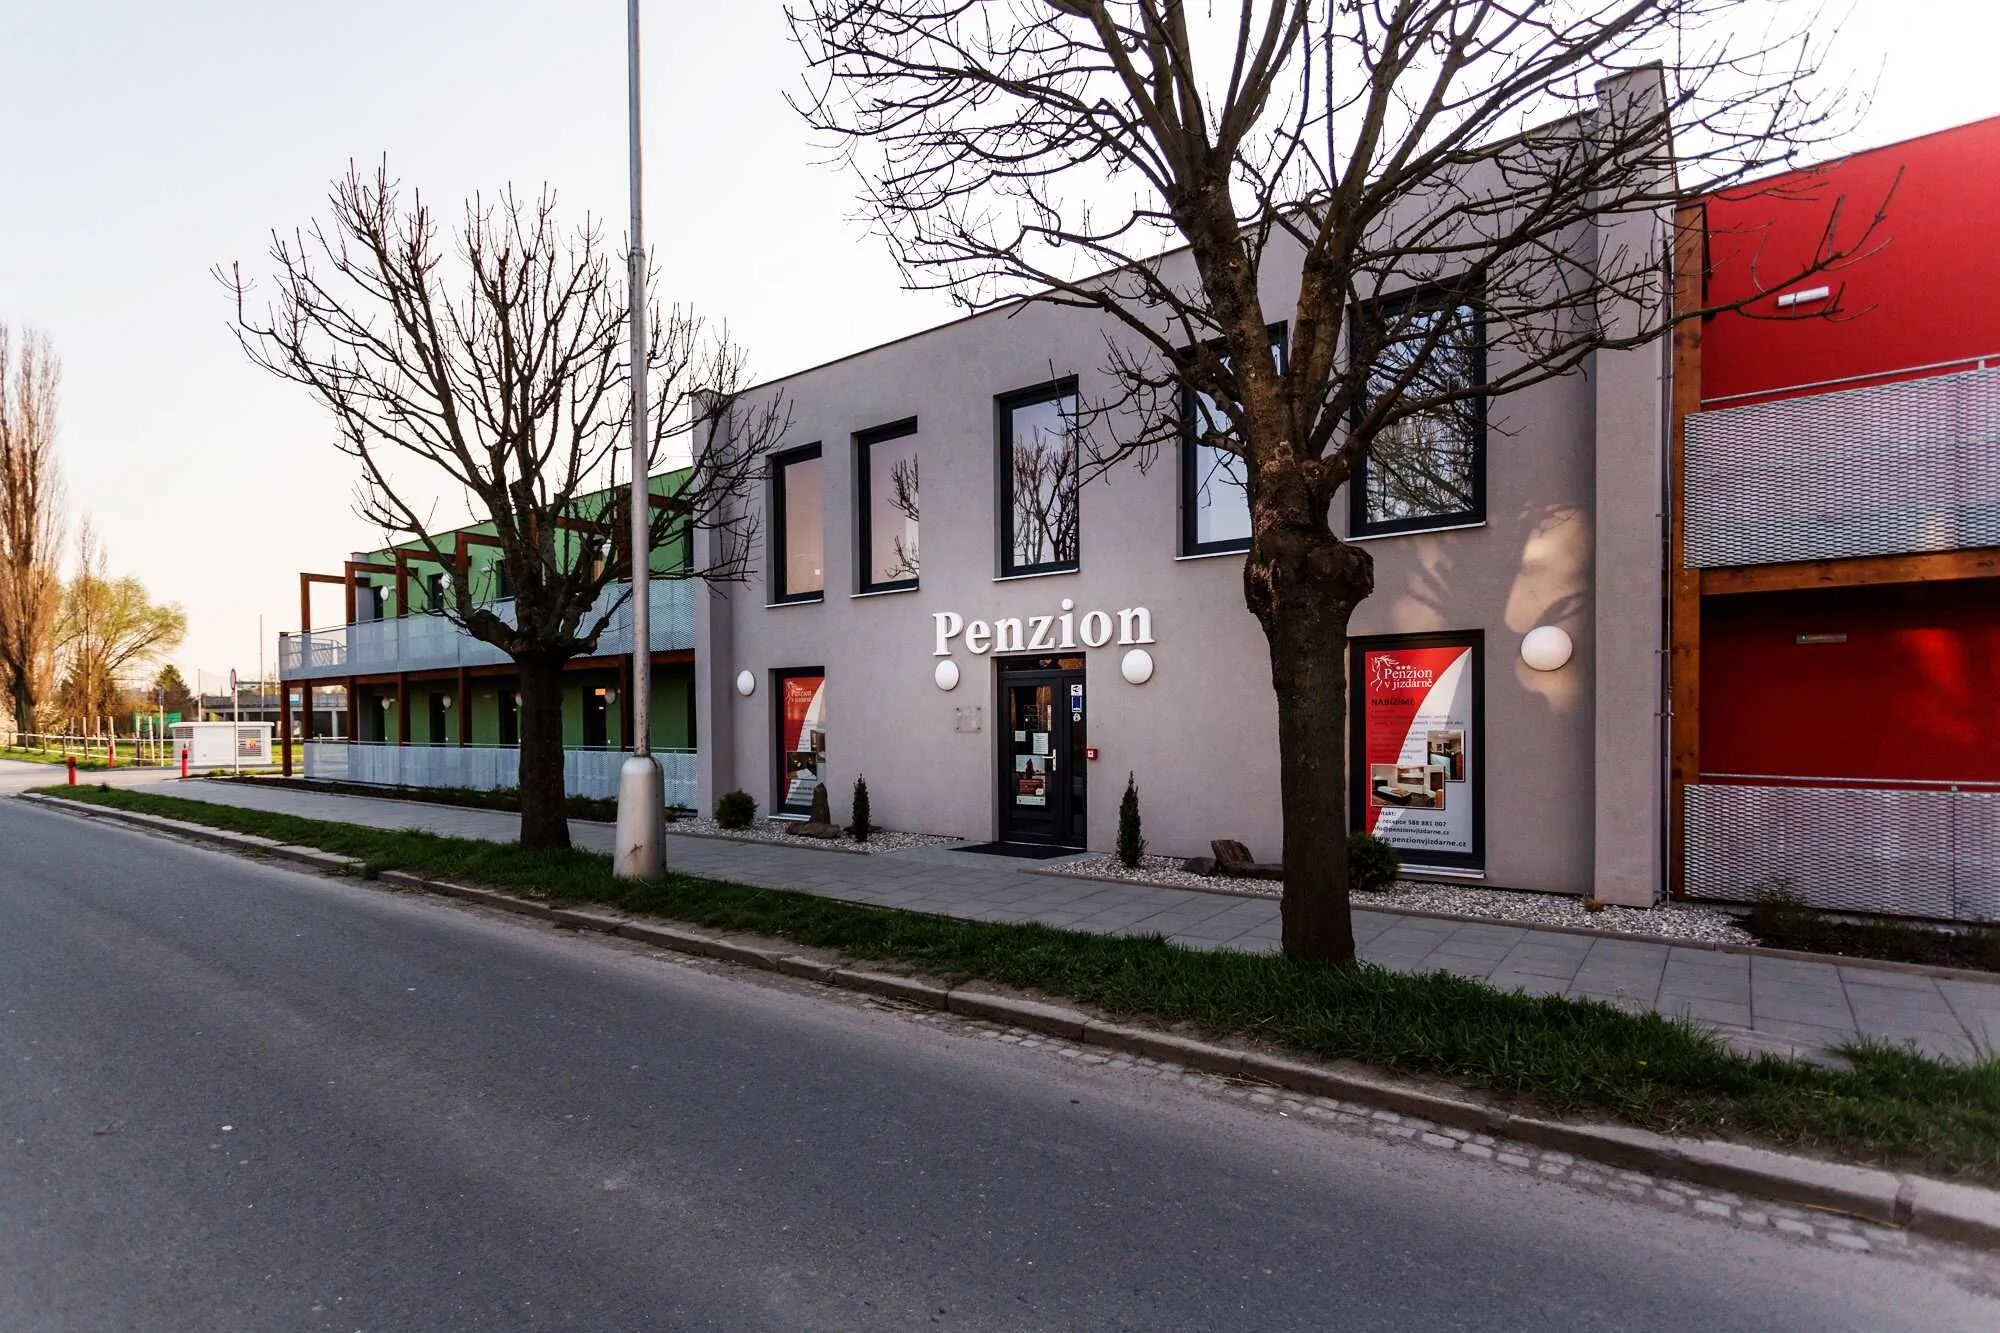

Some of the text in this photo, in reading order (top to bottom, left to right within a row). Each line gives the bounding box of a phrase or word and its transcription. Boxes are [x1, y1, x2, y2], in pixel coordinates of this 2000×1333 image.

[932, 598, 1156, 656] Penzion
[1384, 666, 1433, 680] Penzion
[1384, 679, 1433, 691] v jízdárně
[1371, 826, 1450, 836] fo@penzionvjizdarne.cz
